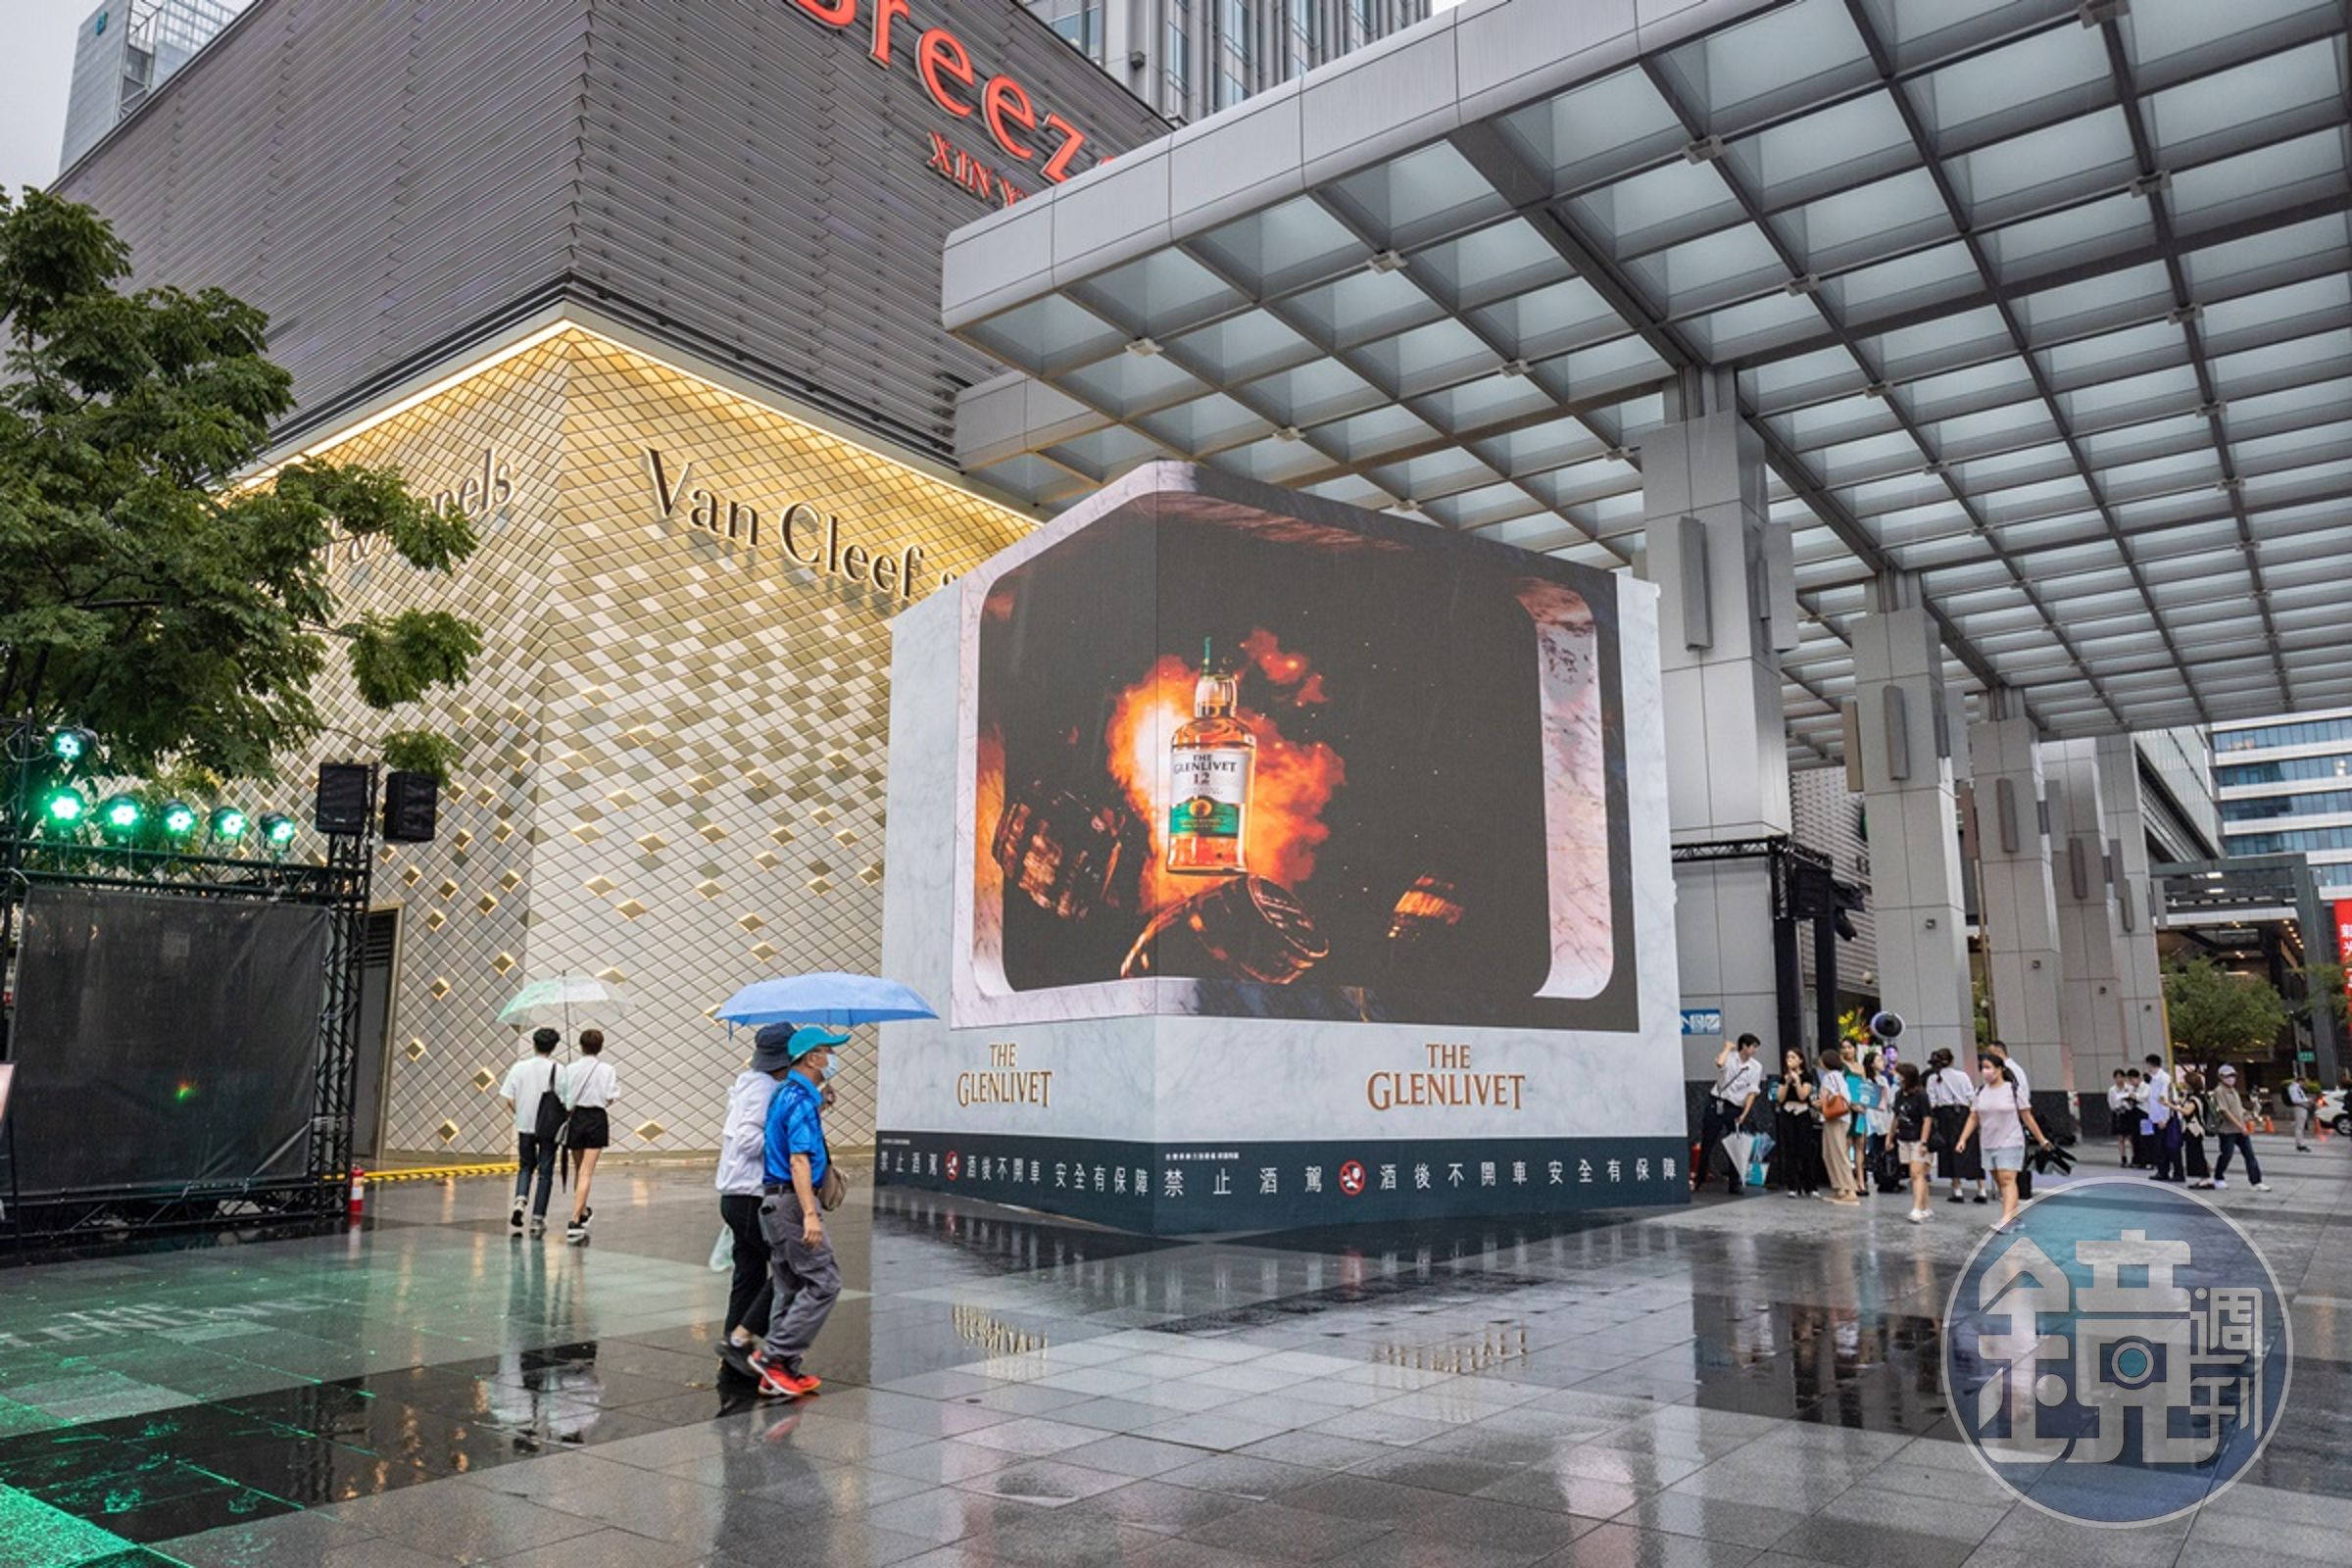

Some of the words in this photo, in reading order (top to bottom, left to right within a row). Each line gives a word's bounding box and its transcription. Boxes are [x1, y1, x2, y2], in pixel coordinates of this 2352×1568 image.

[786, 0, 1115, 184] reez
[925, 130, 994, 199] XIN
[643, 445, 760, 546] Van
[780, 501, 924, 599] Cleef
[1174, 760, 1237, 774] GLENLIVET
[1194, 771, 1210, 785] 12
[989, 1043, 1016, 1067] THE
[1425, 1044, 1472, 1069] THE
[956, 1070, 1054, 1108] GLENLIVET
[1366, 1070, 1526, 1111] GLENLIVET
[1163, 1166, 1323, 1199] 禁止酒駕
